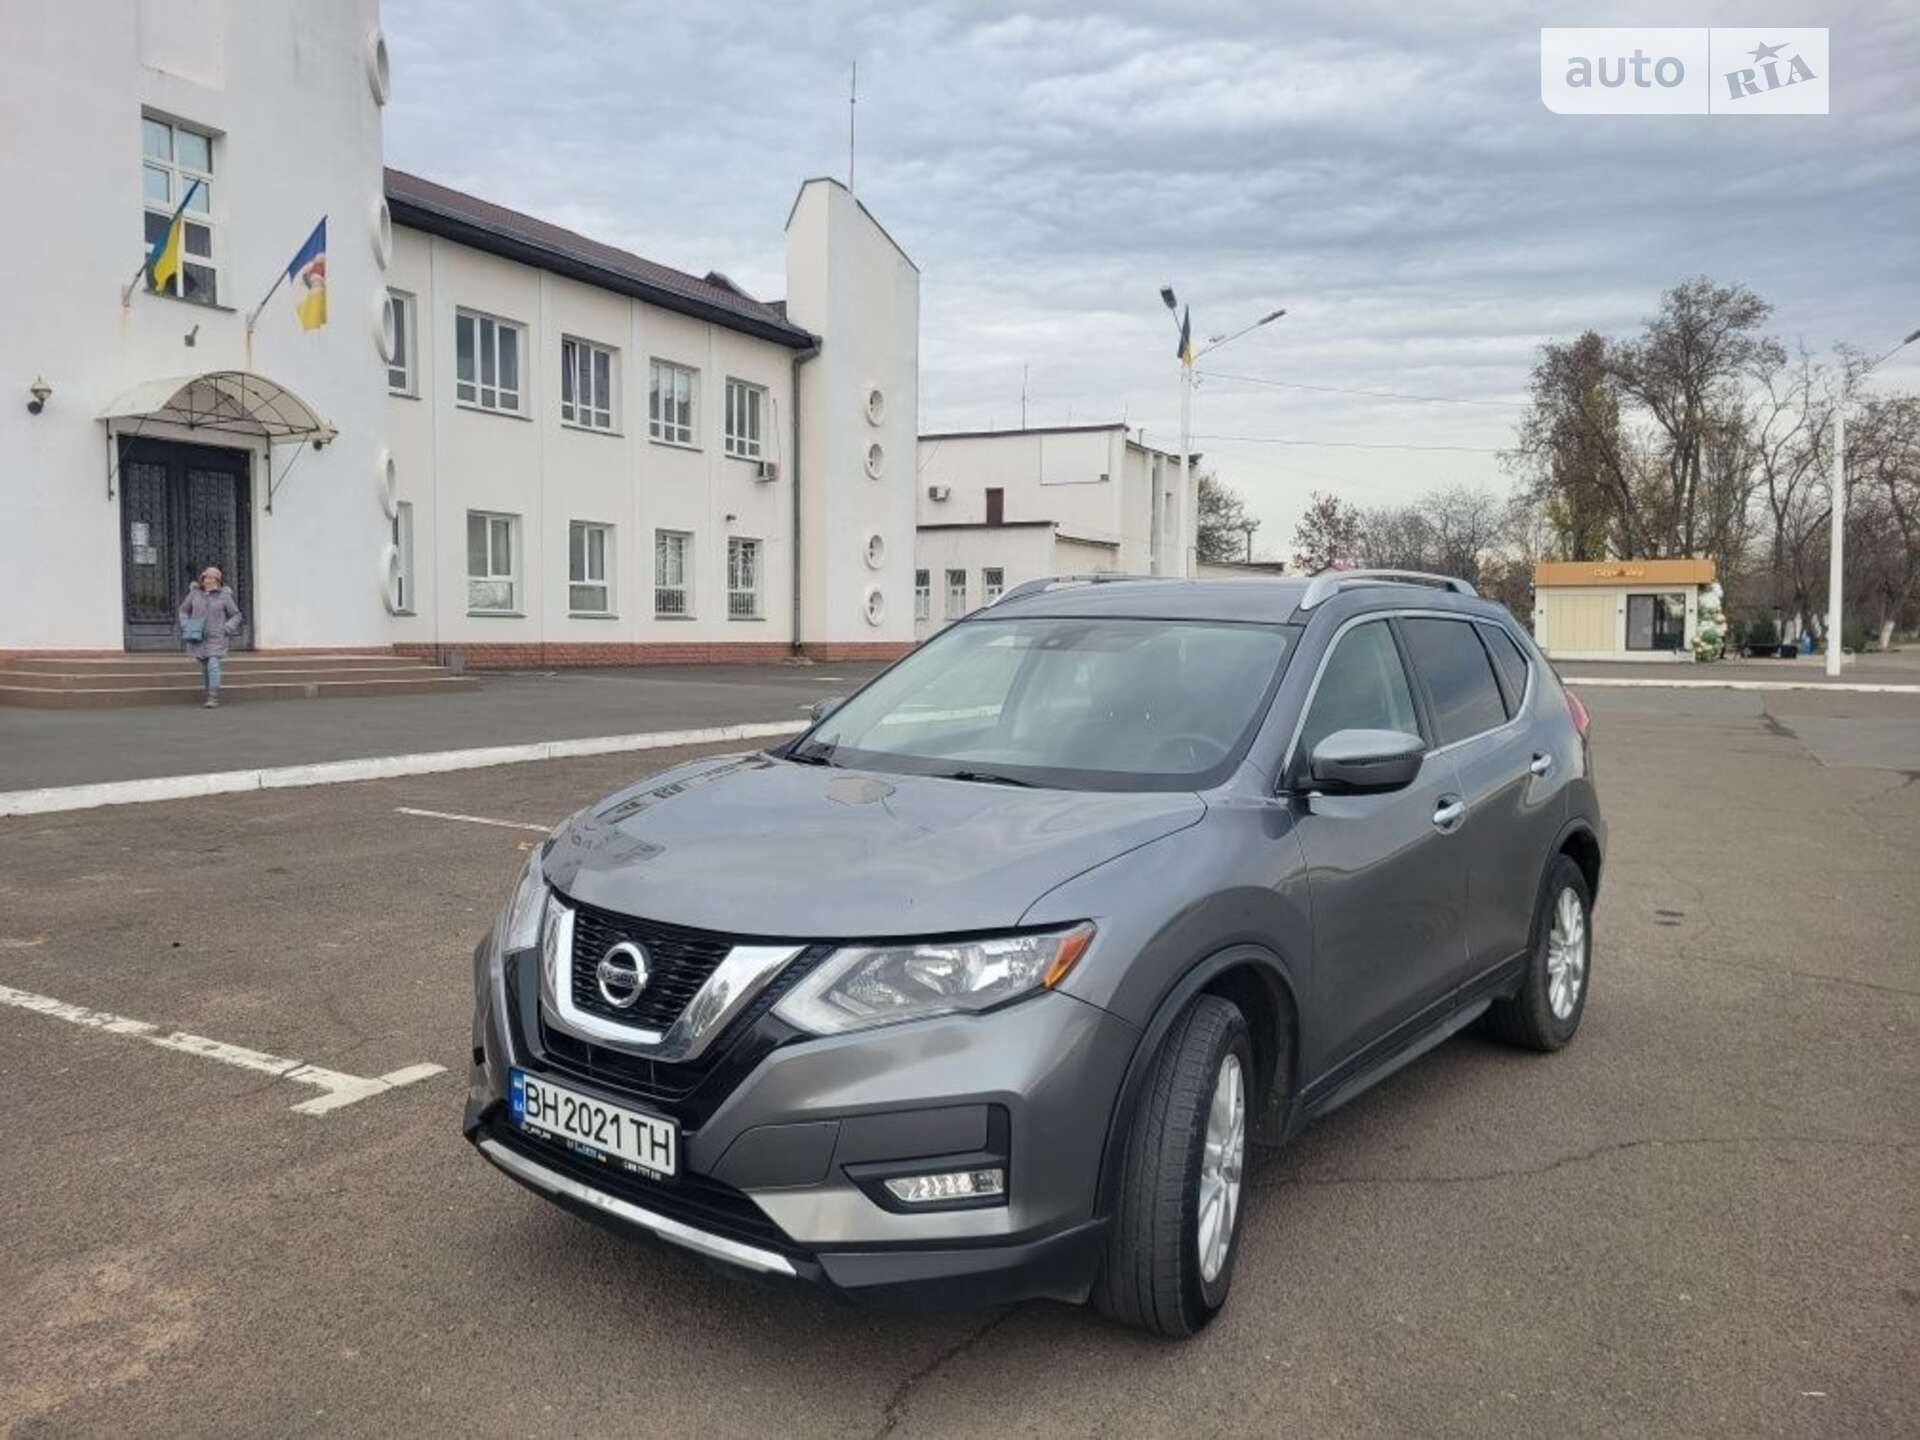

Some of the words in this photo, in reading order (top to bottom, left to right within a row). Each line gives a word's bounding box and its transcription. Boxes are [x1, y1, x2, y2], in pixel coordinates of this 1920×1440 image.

[525, 1081, 559, 1127] BH
[564, 1097, 622, 1149] 2021
[630, 1118, 670, 1166] TH
